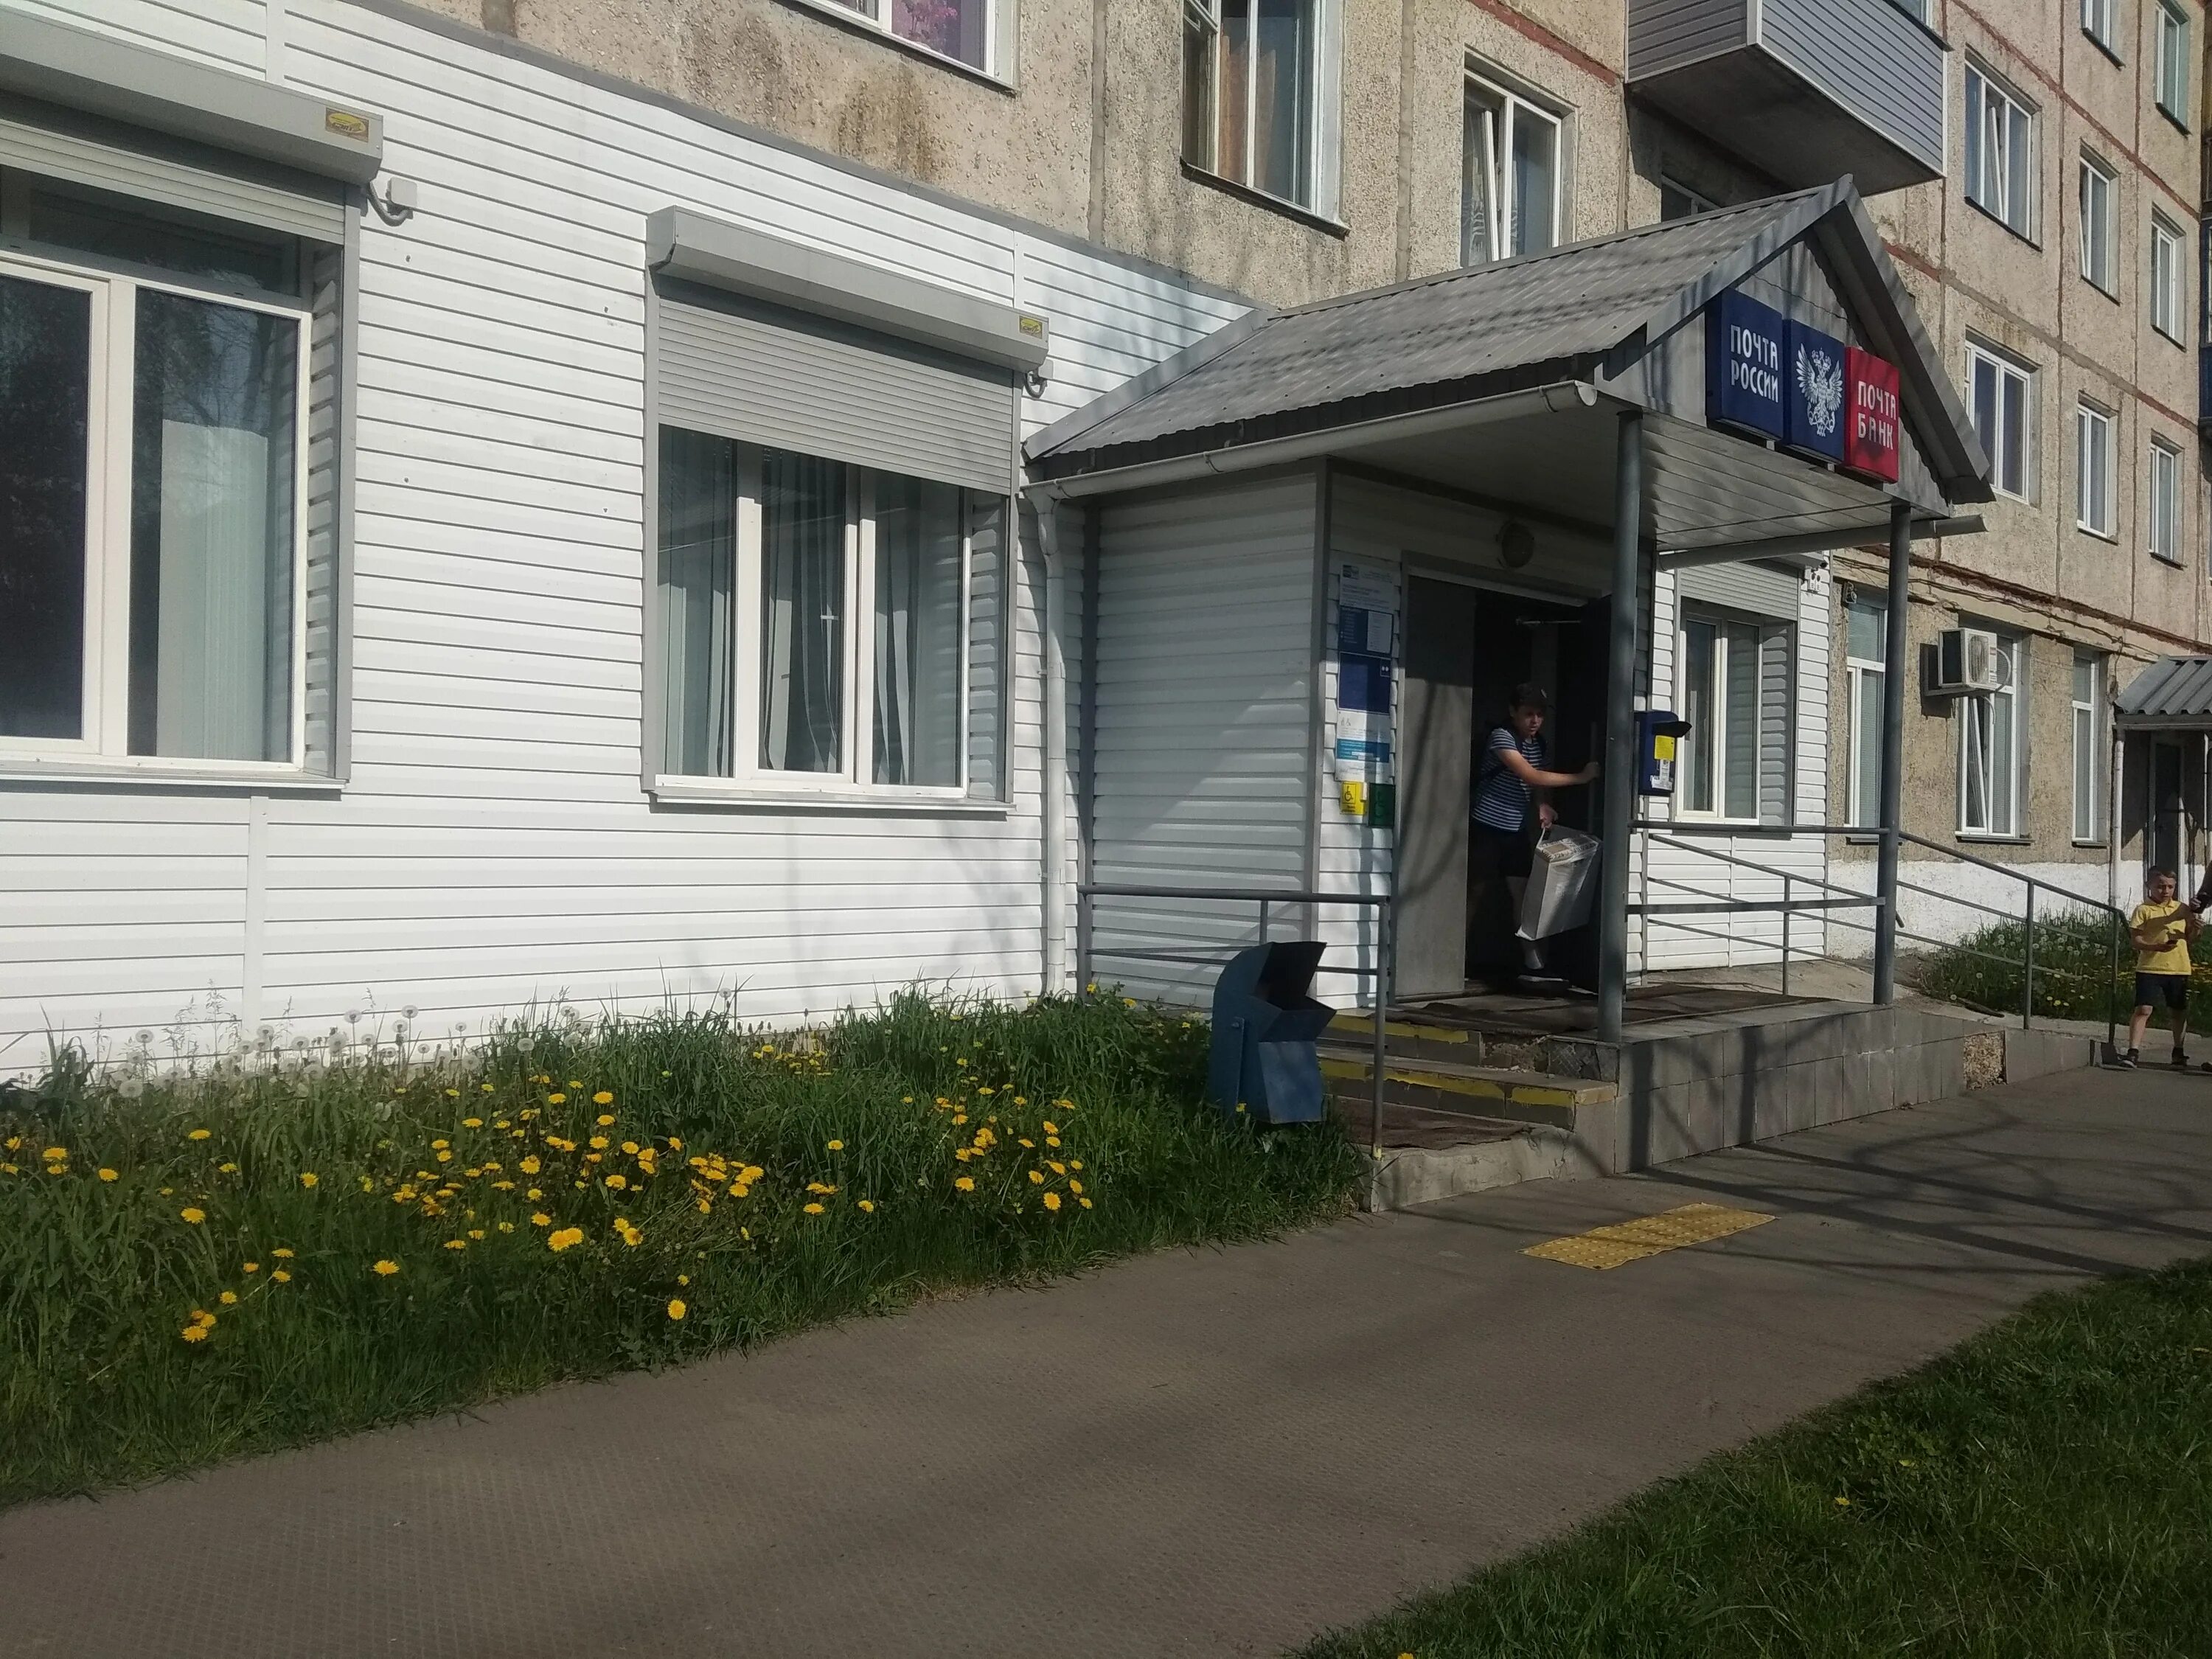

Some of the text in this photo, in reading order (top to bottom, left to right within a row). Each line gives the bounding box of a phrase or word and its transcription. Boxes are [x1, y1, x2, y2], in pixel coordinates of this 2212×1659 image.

[1730, 324, 1778, 371] ПОЧТА
[1731, 360, 1778, 403] РОССИИ
[1857, 380, 1896, 420] ПОЧТА
[1857, 413, 1893, 451] БАНК
